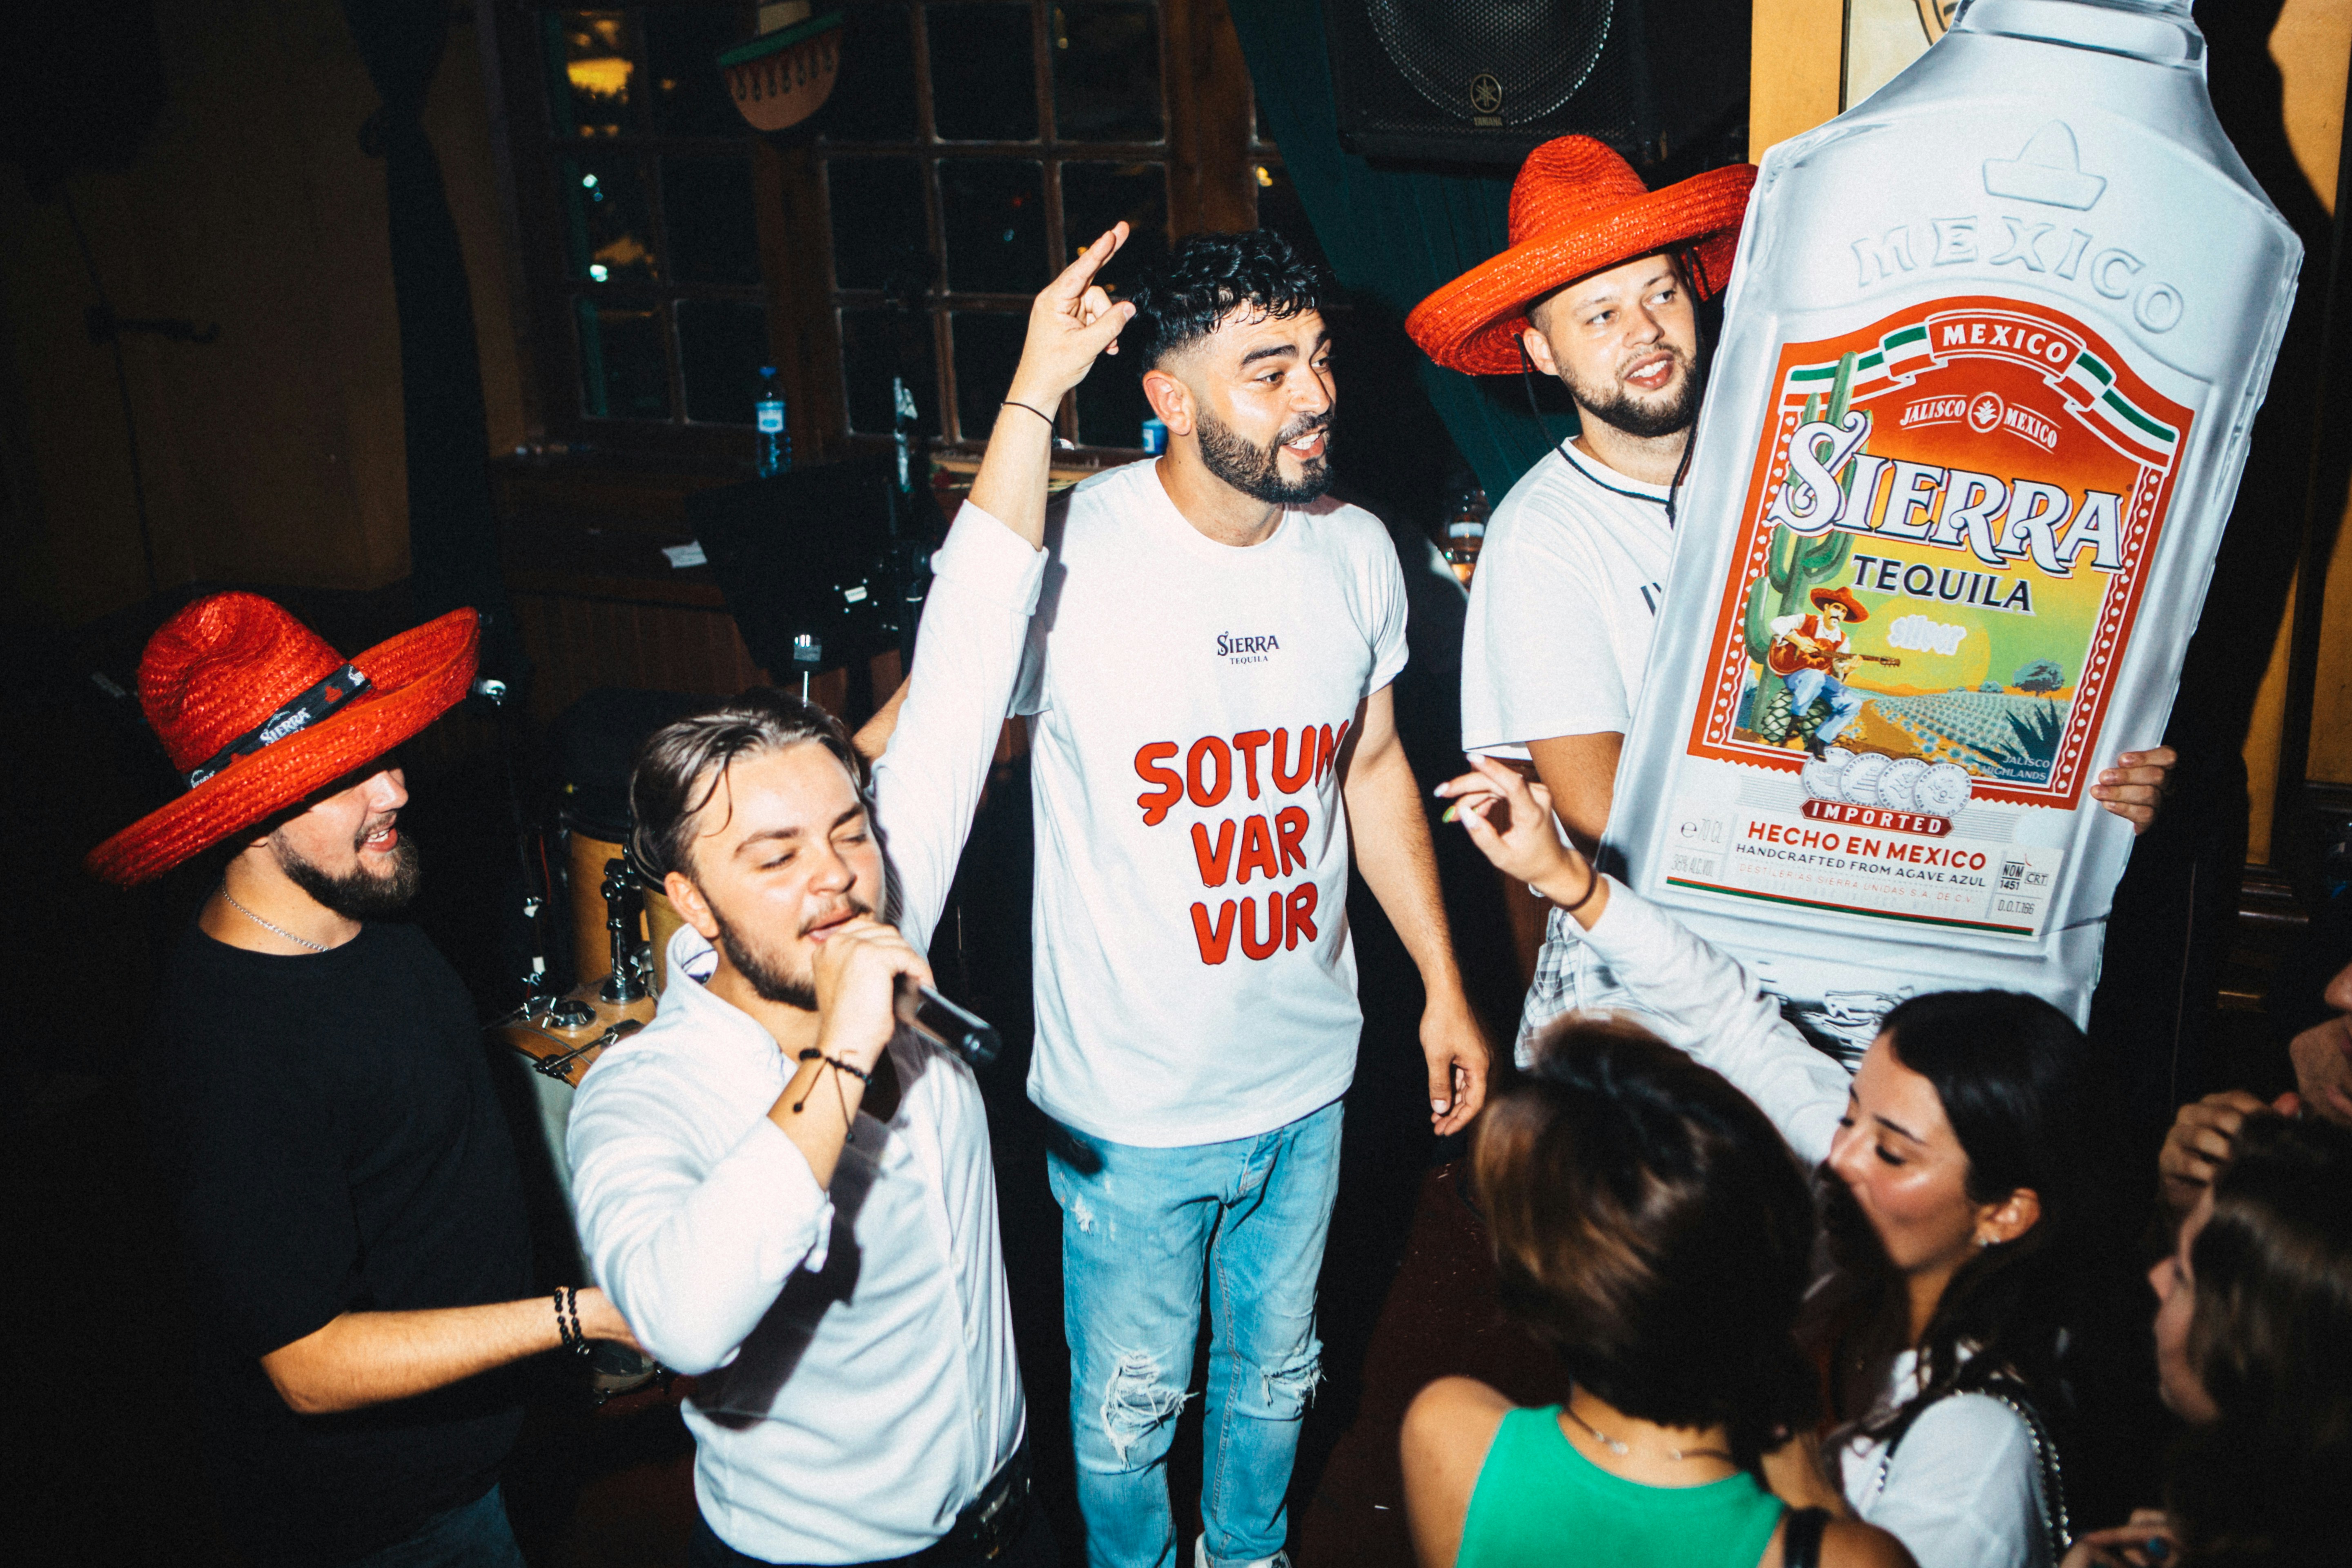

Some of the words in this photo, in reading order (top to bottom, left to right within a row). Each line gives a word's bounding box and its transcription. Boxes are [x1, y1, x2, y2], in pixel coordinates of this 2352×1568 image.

[1851, 216, 2184, 334] MEXICO
[1942, 324, 2068, 363] MEXICO
[1900, 399, 1967, 426] JALISCO
[2003, 408, 2058, 448] MEXICO
[1766, 410, 2126, 579] SIERRA
[1851, 554, 2035, 614] TEQUILA
[1217, 631, 1280, 656] SIERRA
[1229, 655, 1268, 665] TEQUILA
[259, 707, 312, 744] SIERRA
[1982, 765, 2046, 781] HIGHLANDS
[2003, 756, 2050, 768] JALISCO
[1811, 802, 1942, 834] IMPORTED
[1191, 806, 1310, 888] VAR
[1748, 821, 1840, 851] HECHO
[1846, 836, 1882, 858] EN
[1886, 842, 1986, 871] MEXICO
[1736, 843, 1845, 868] HANDCRAFTED
[1850, 861, 1891, 875] FROM
[1895, 868, 1945, 882] AGAVE
[1949, 874, 1986, 887] AZUL
[2002, 864, 2025, 878] NOM
[2027, 873, 2047, 884] CRT
[1817, 876, 1858, 888] SIERRA
[1863, 883, 1905, 895] UNIDAS
[1937, 892, 1951, 901] DE
[2000, 879, 2020, 891] 1451
[1190, 881, 1319, 965] VUR
